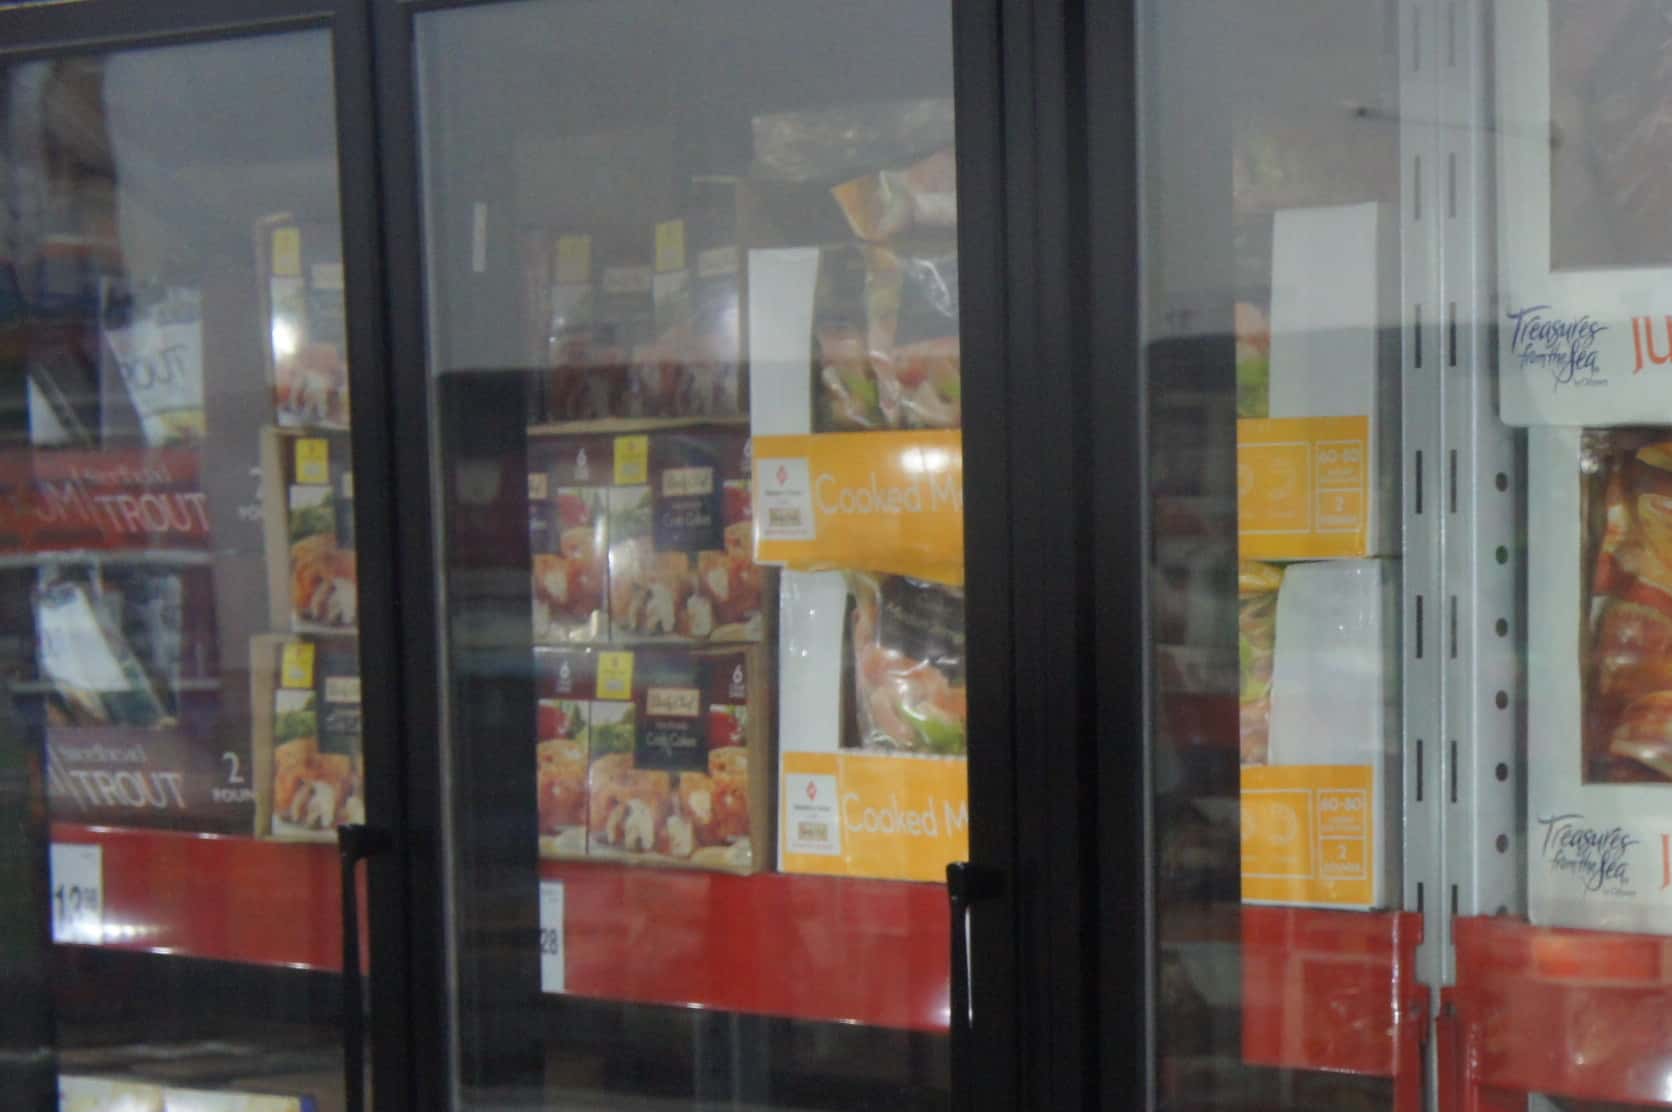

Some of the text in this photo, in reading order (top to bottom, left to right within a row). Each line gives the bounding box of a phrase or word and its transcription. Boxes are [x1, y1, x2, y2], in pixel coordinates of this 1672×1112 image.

[1506, 304, 1608, 355] Treasures
[94, 492, 210, 533] TROUT
[815, 473, 923, 516] Cooked
[222, 751, 246, 785] 2
[69, 770, 188, 811] TROUT
[843, 792, 939, 839] Cooked
[1537, 812, 1640, 857] Treasures
